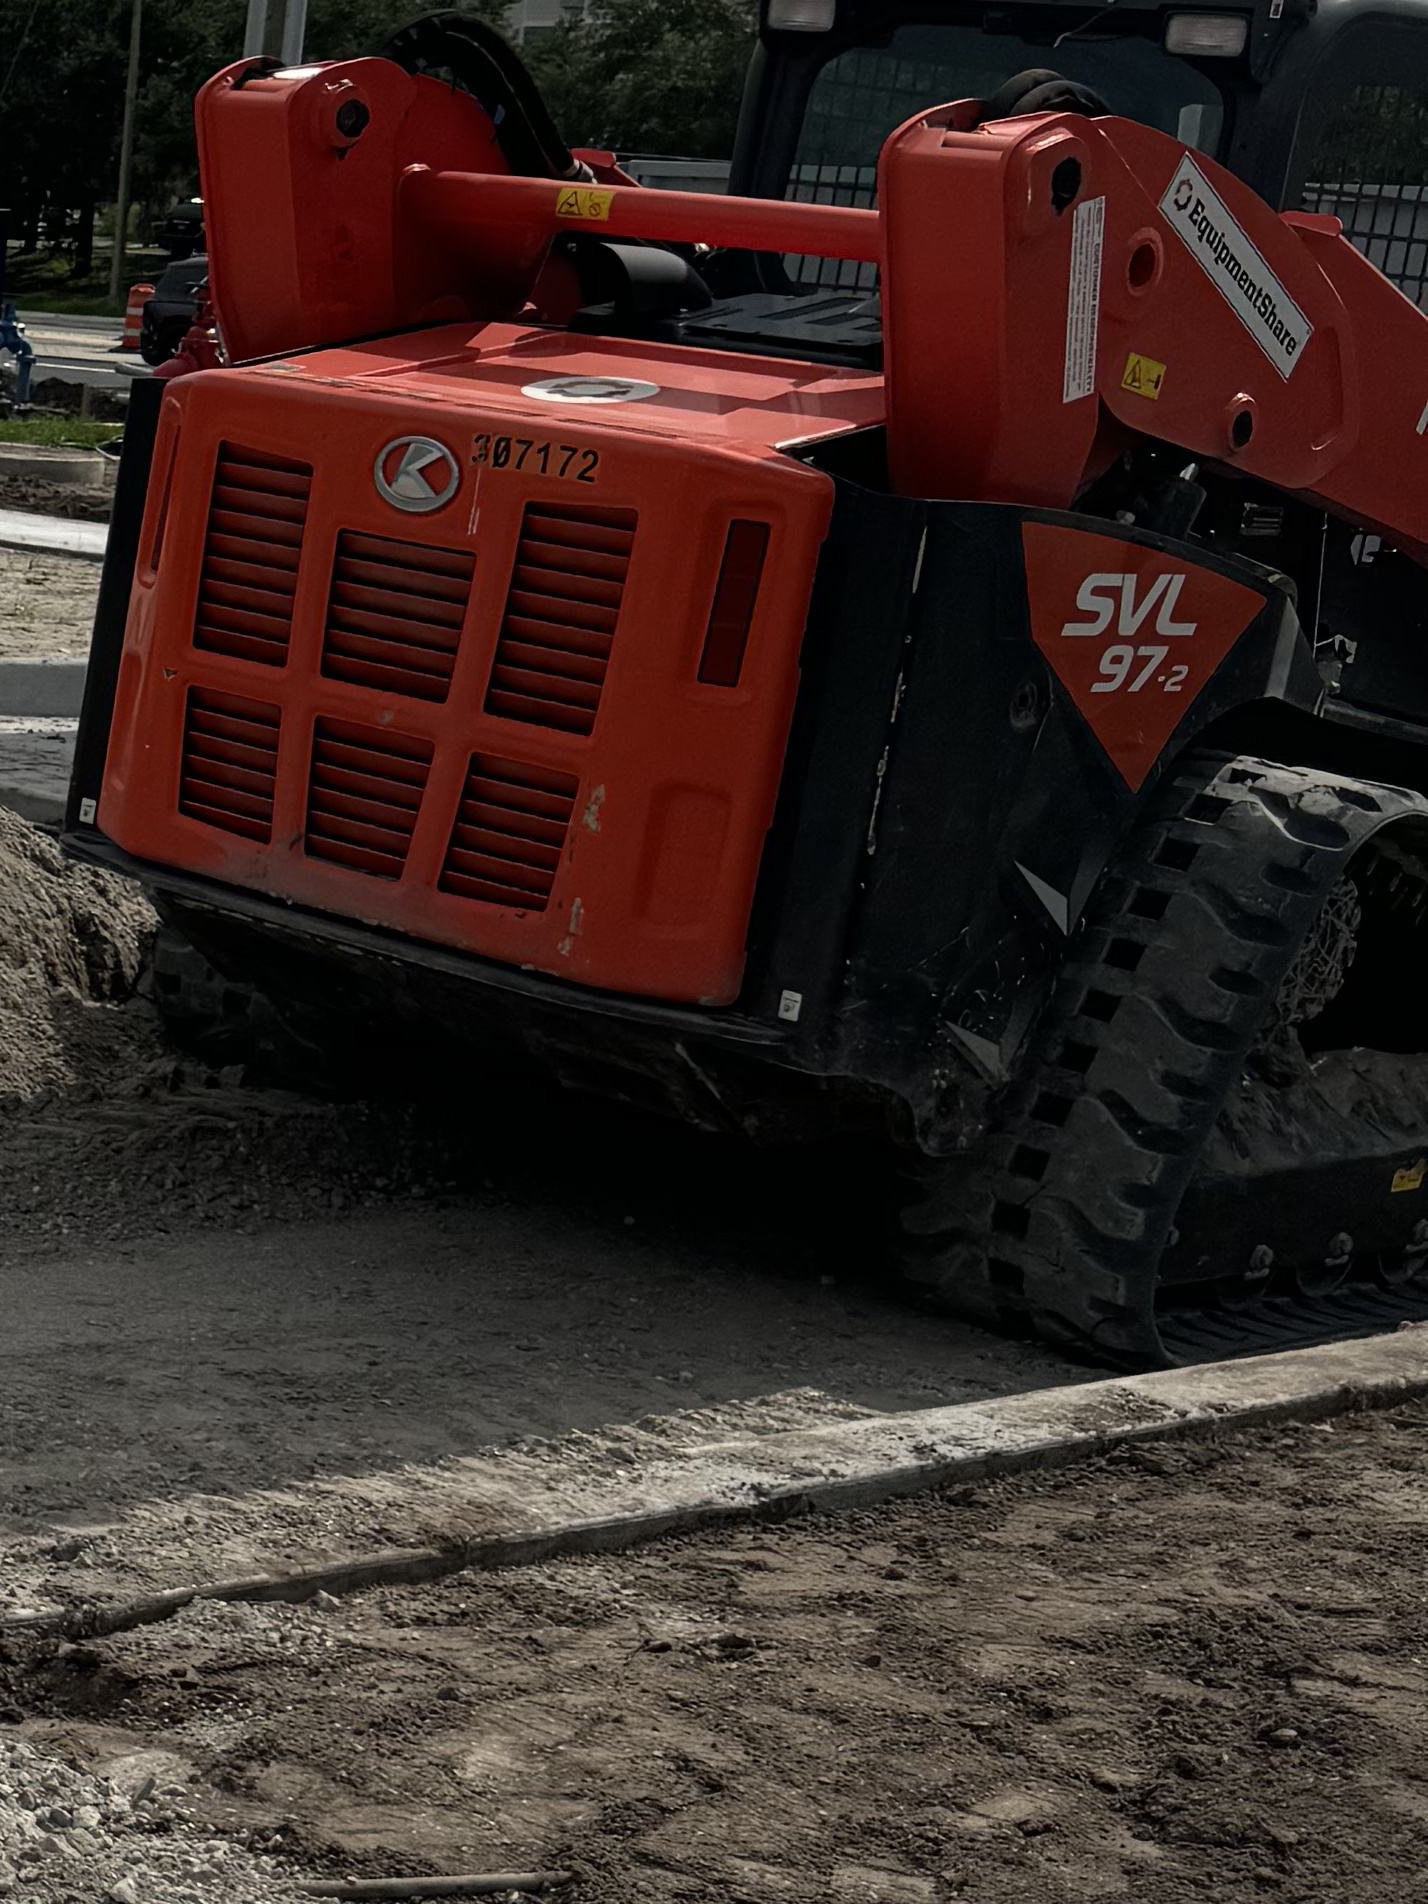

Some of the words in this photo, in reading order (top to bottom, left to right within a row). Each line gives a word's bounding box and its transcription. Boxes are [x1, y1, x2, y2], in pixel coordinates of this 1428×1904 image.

[1188, 197, 1298, 356] EquipmentShare
[471, 433, 600, 483] 307172
[1060, 573, 1198, 636] SVL
[1090, 644, 1189, 693] 97-2
